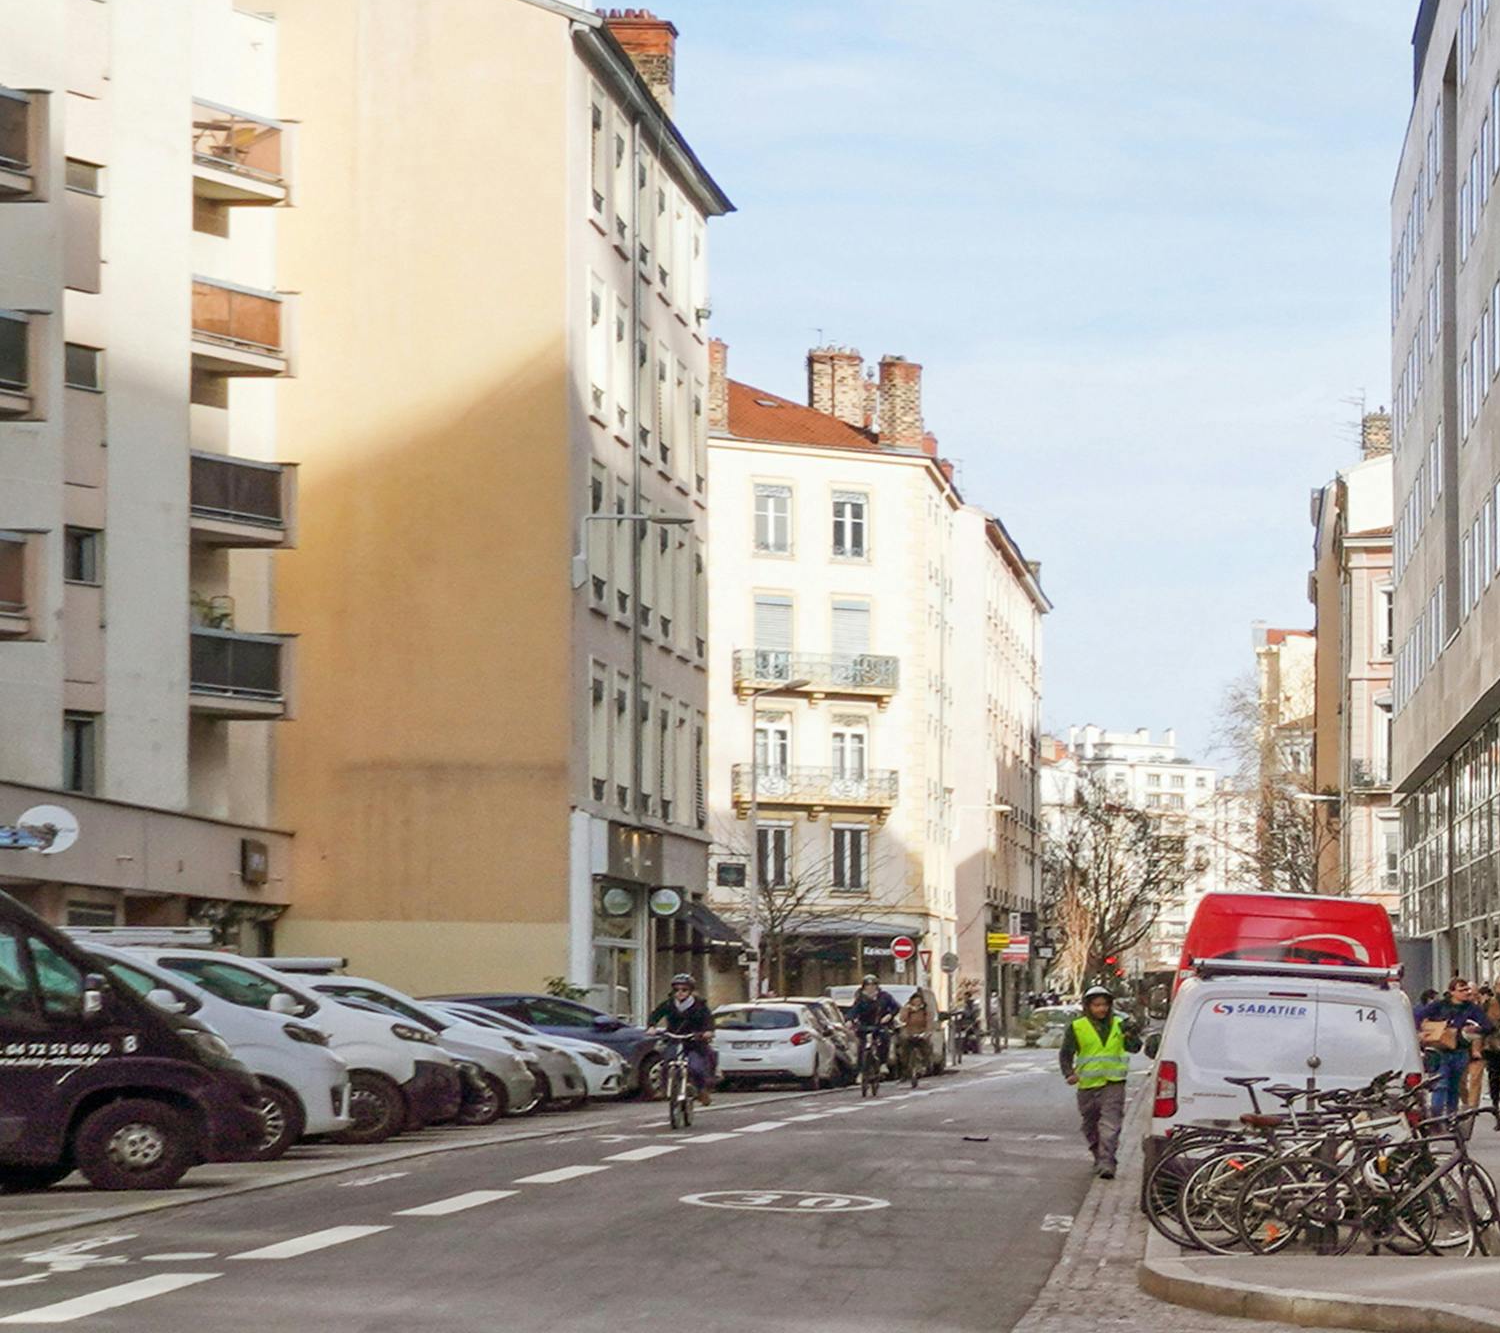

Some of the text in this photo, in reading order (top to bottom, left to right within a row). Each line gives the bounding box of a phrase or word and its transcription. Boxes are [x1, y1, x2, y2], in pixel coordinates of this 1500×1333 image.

[1236, 1003, 1308, 1017] SABATIER
[1355, 1009, 1378, 1023] 14
[723, 1192, 851, 1208] 30
